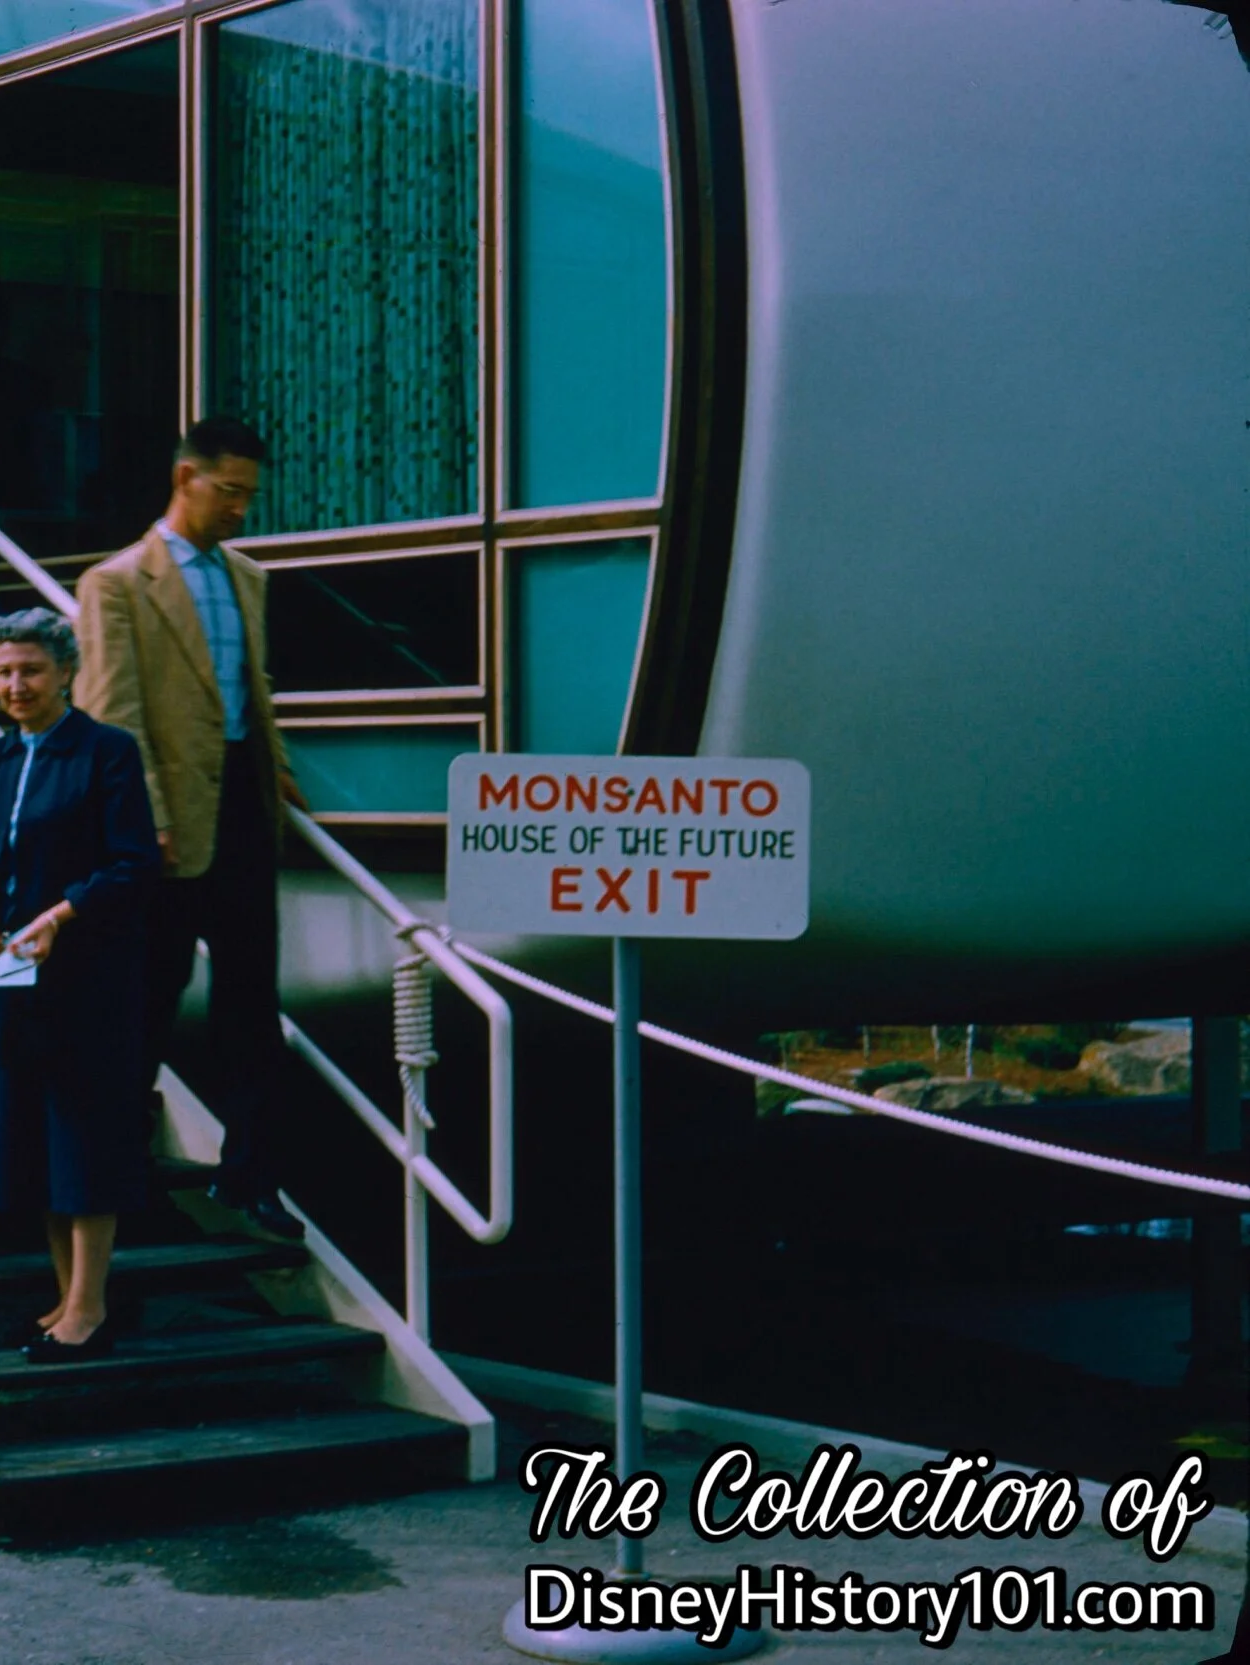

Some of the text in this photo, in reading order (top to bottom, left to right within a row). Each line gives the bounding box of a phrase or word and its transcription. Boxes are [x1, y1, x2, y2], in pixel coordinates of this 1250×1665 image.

[479, 773, 779, 817] MONSANTO
[462, 824, 796, 859] HOUSE OF THE FUTURE
[550, 867, 711, 915] EXIT
